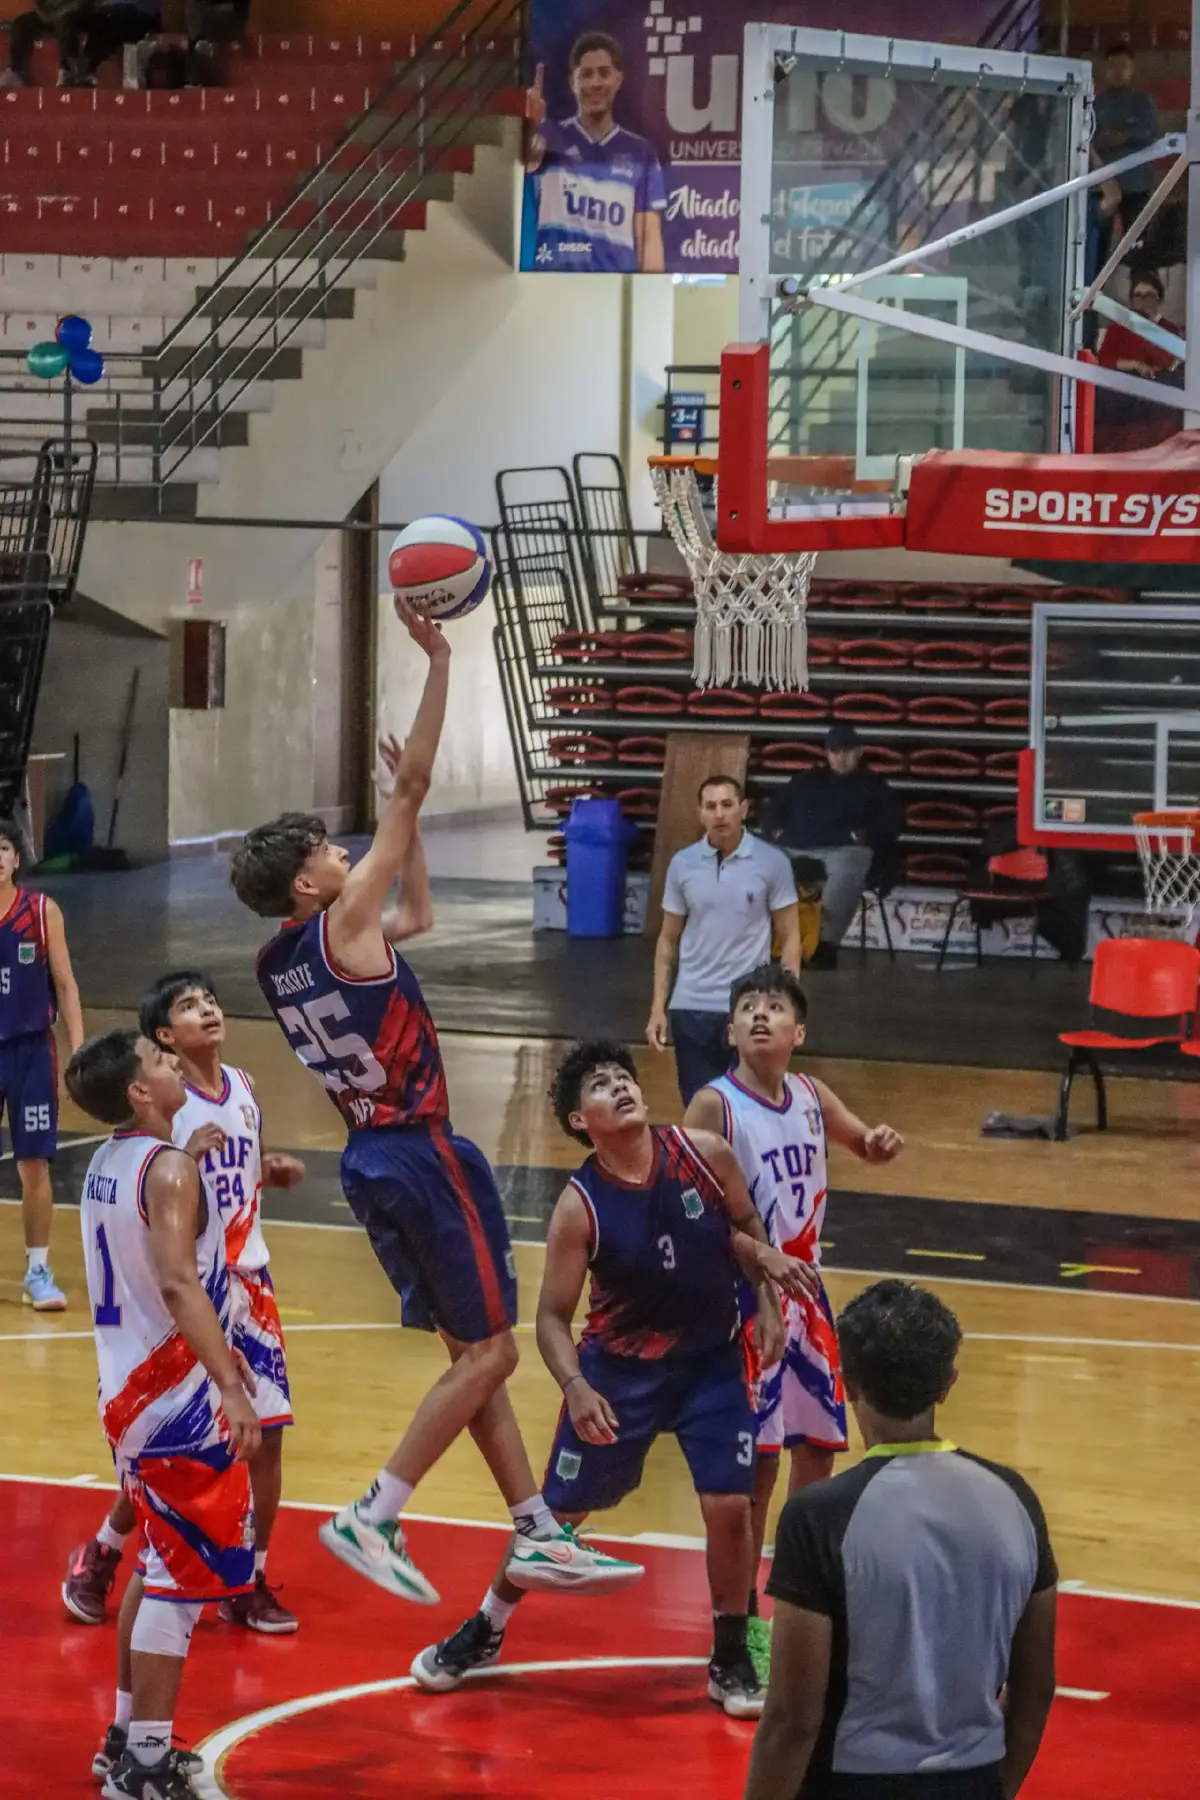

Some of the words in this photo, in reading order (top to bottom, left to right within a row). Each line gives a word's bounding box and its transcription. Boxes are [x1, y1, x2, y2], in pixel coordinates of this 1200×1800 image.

[0, 967, 11, 994] 5
[277, 989, 388, 1093] 25
[24, 1104, 50, 1132] 55
[215, 1173, 245, 1209] 24
[791, 1182, 806, 1219] 7
[657, 1233, 677, 1270] 3
[95, 1222, 122, 1328] 1
[736, 1430, 754, 1467] 3
